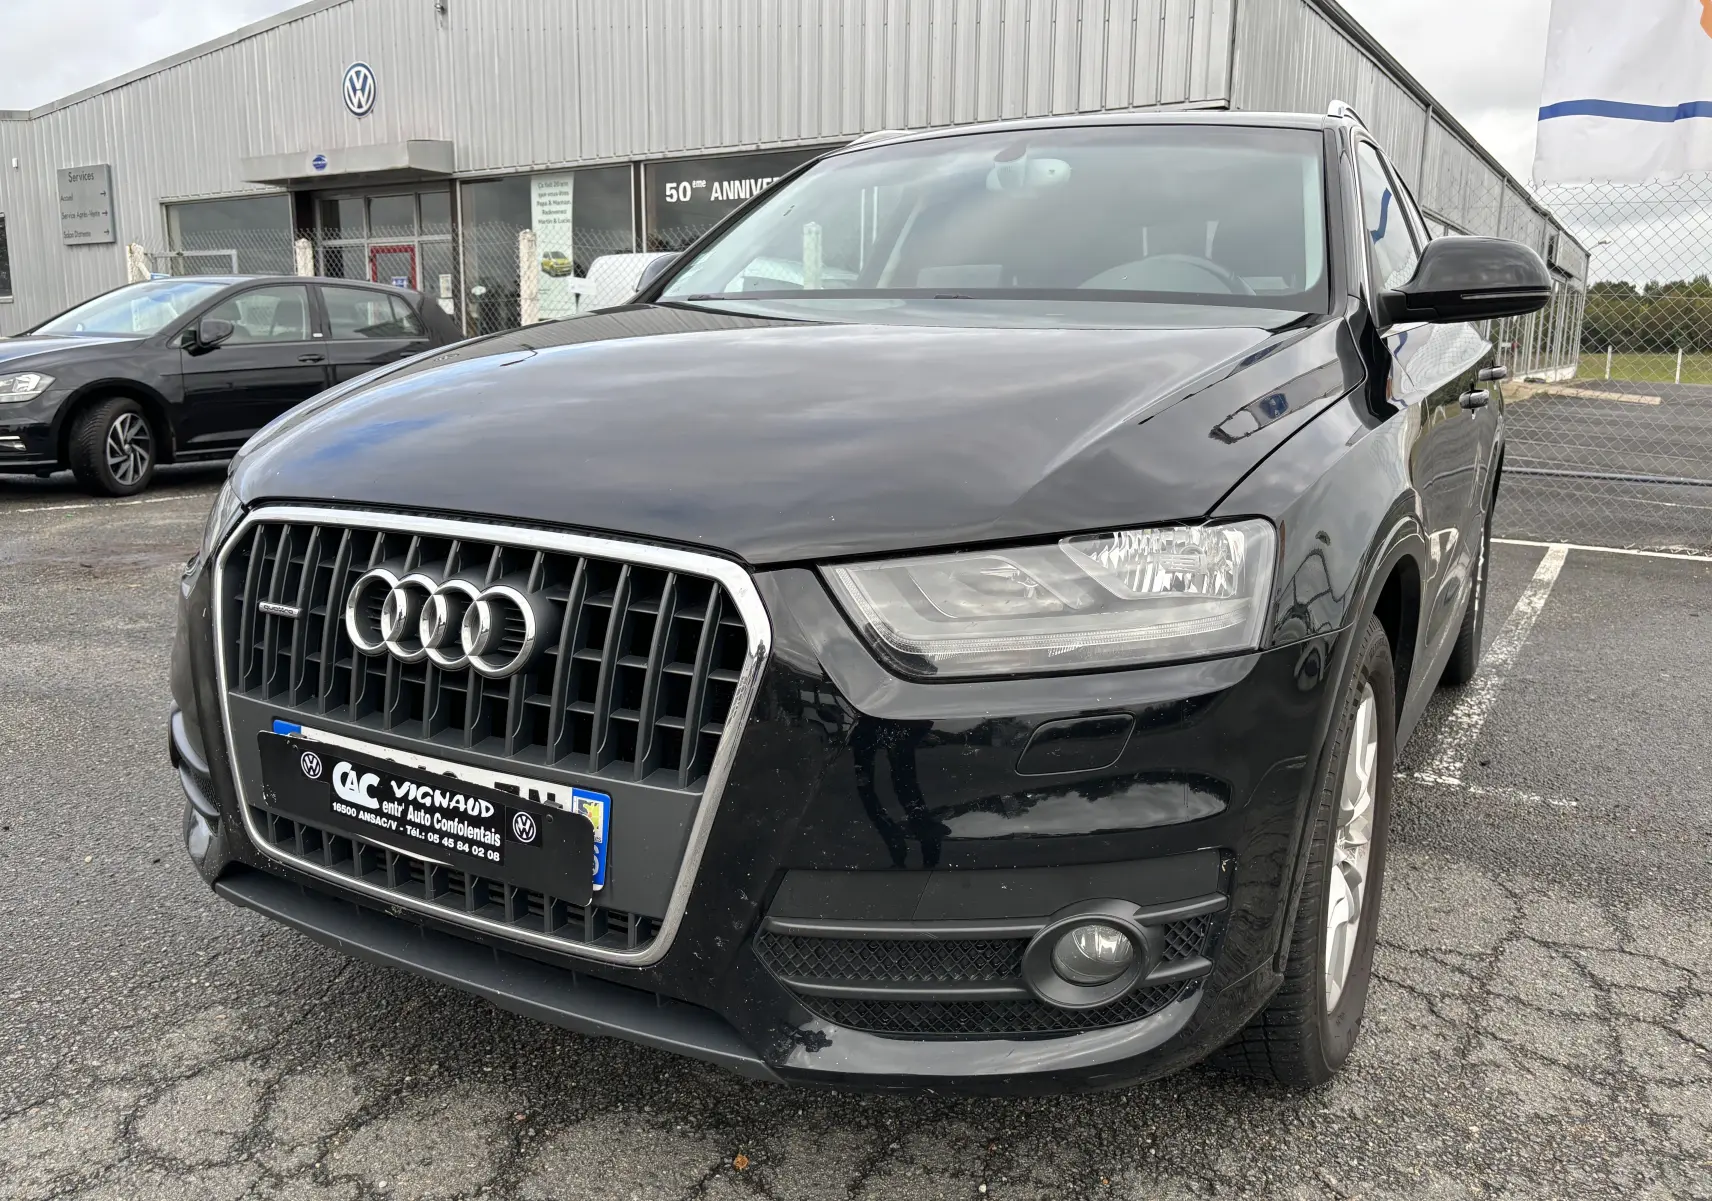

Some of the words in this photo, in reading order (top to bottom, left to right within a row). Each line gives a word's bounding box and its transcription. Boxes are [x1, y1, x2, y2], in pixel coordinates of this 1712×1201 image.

[68, 171, 94, 183] Services
[263, 604, 294, 615] quattro
[332, 761, 380, 809] CAC
[390, 780, 495, 818] VIGNAUD
[332, 801, 357, 817] 16500
[358, 810, 398, 831] ANSAC/V
[427, 832, 440, 844] 05
[441, 836, 455, 848] 45
[456, 841, 470, 853] 84
[471, 845, 485, 857] 02
[487, 850, 501, 862] 08
[407, 805, 431, 826] Auto
[433, 812, 501, 847] Confolentais
